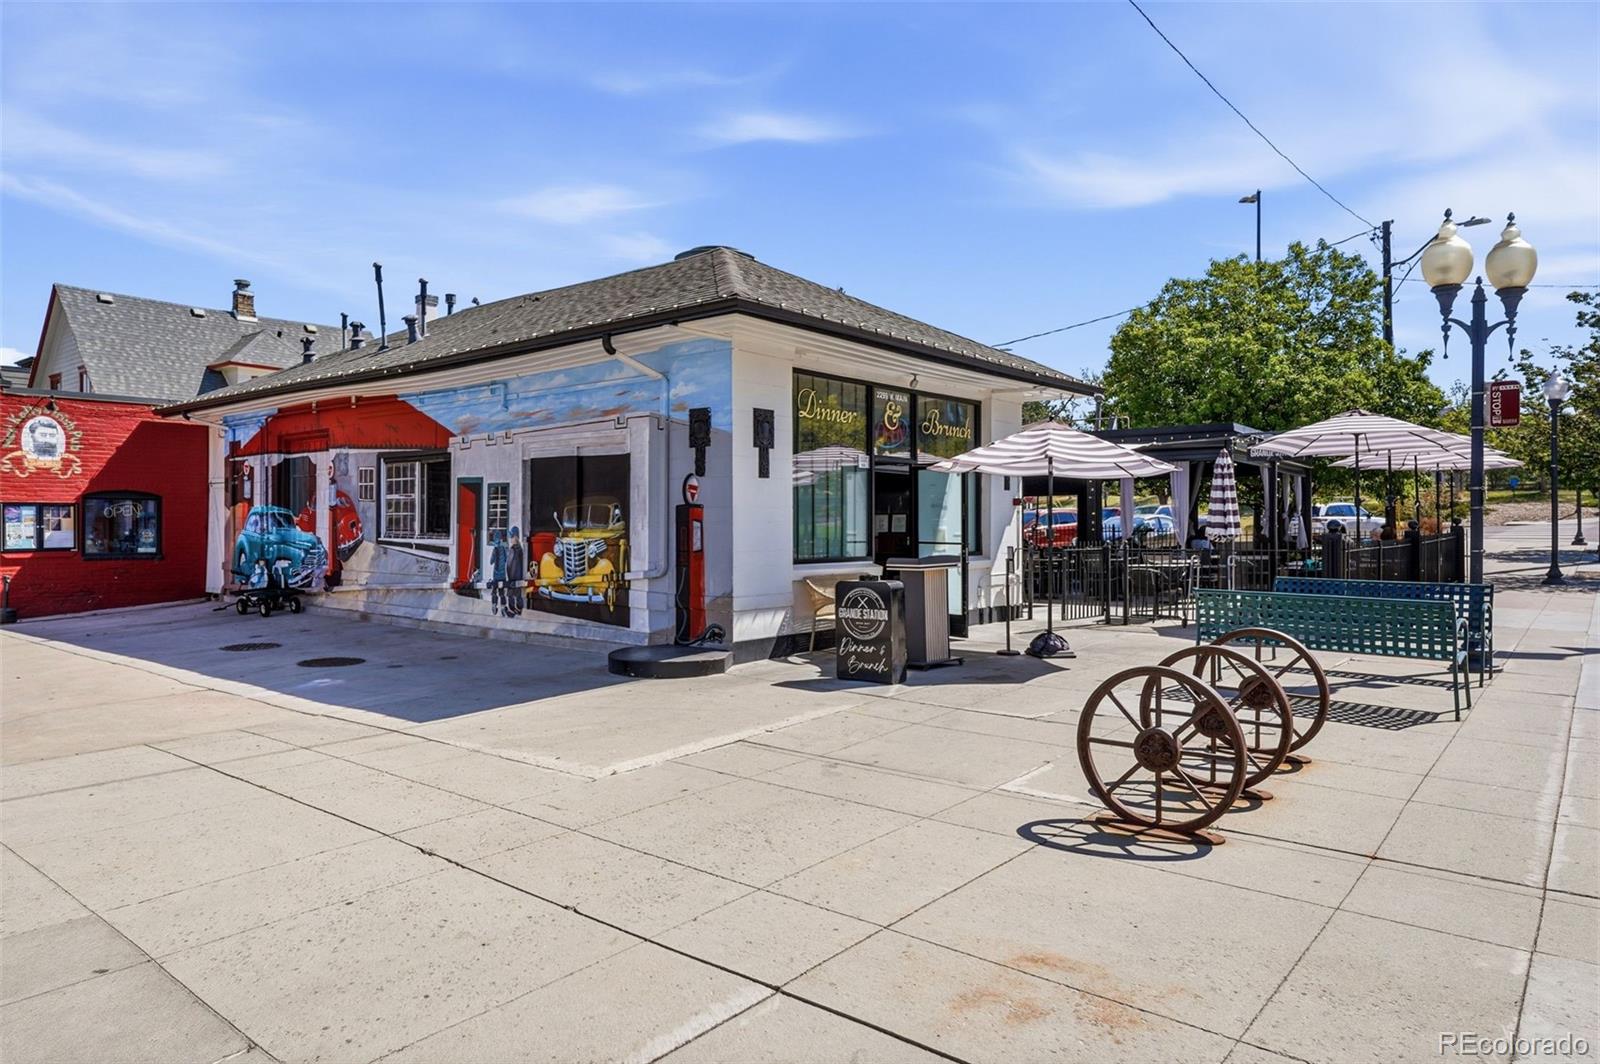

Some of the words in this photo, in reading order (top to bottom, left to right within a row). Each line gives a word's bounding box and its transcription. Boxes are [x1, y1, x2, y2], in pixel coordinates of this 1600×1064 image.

[798, 388, 857, 425] Dinner
[884, 402, 902, 431] &
[922, 409, 971, 439] Brunch
[104, 502, 141, 519] OPEN
[838, 607, 862, 619] GRANDE
[863, 609, 888, 620] STATION
[839, 637, 877, 656] Dinner
[847, 655, 889, 674] Brunch
